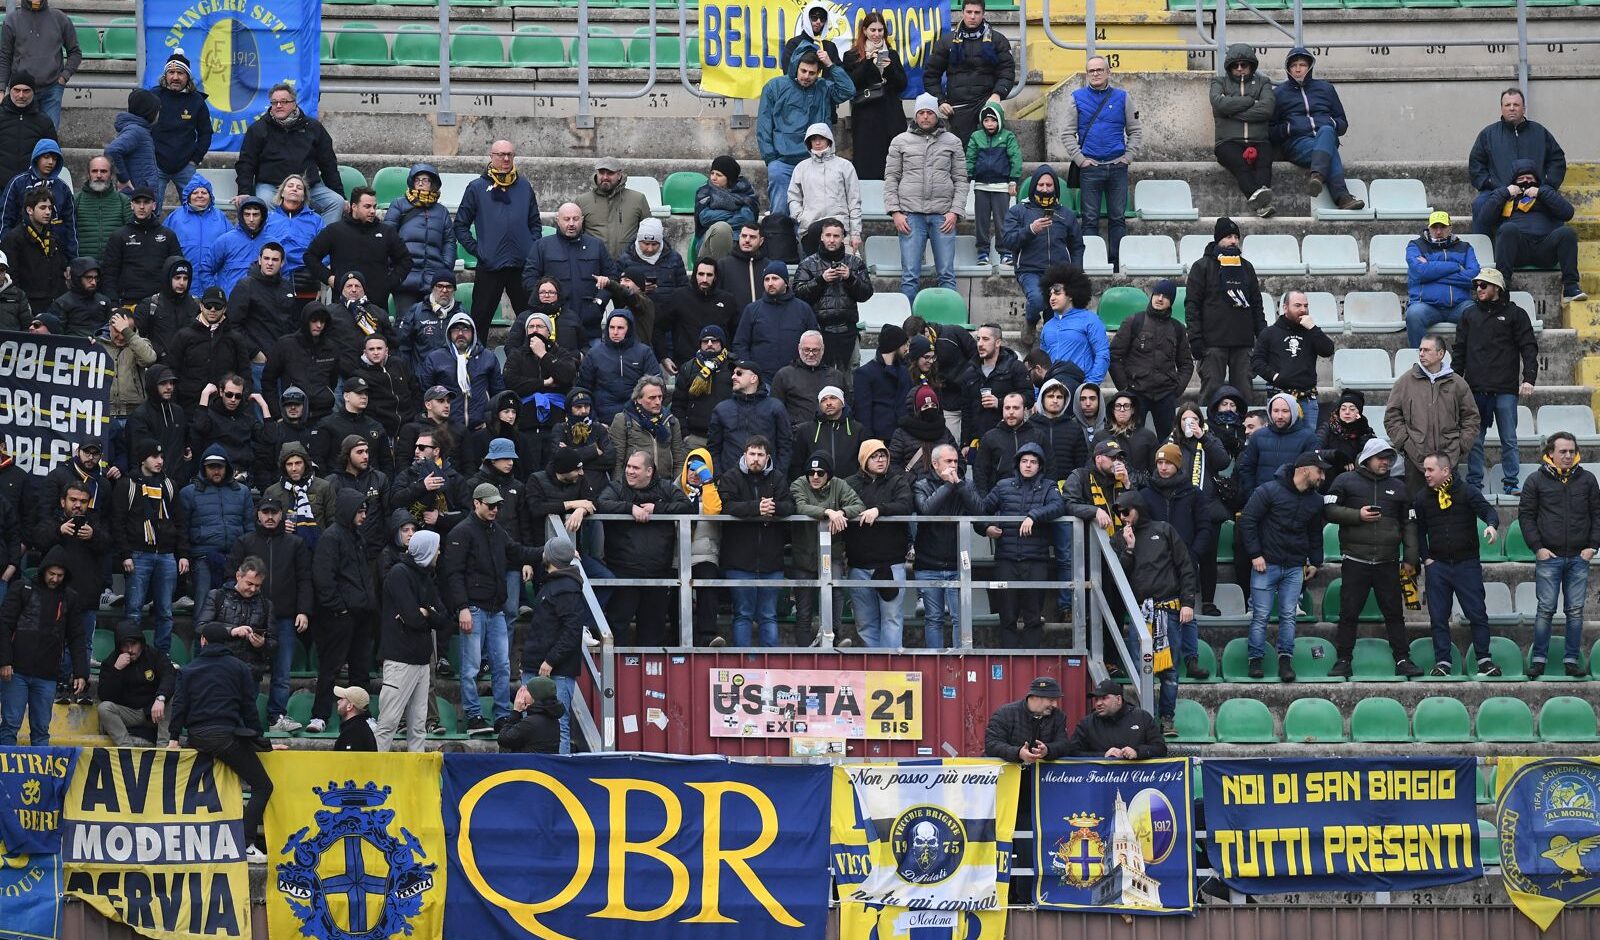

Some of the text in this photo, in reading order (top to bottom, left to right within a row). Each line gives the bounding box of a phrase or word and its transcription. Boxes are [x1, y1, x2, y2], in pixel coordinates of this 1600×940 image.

[164, 0, 246, 49] SPINGERE
[704, 4, 784, 68] BELLI
[232, 53, 256, 67] 1912
[1106, 54, 1120, 69] 13
[713, 684, 861, 716] USCITA
[871, 690, 913, 720] 21
[766, 721, 808, 733] EXI
[881, 721, 909, 733] BIS
[81, 747, 223, 815] AVIA
[848, 768, 998, 791] Non posso più venir
[1041, 770, 1184, 783] Modena Football Club 1912
[1222, 769, 1457, 805] NOI DI SAN BIAGIO
[14, 809, 60, 832] BERI
[895, 809, 960, 836] VECCHIE BRIGATE
[1153, 820, 1171, 832] 1912
[1561, 809, 1595, 820] MODNA
[72, 823, 240, 862] MODENA
[942, 841, 960, 854] 75
[1214, 823, 1474, 879] TUTTI PRESENTI
[457, 769, 806, 940] QBR
[279, 881, 309, 897] AVIA
[909, 912, 952, 926] Modena
